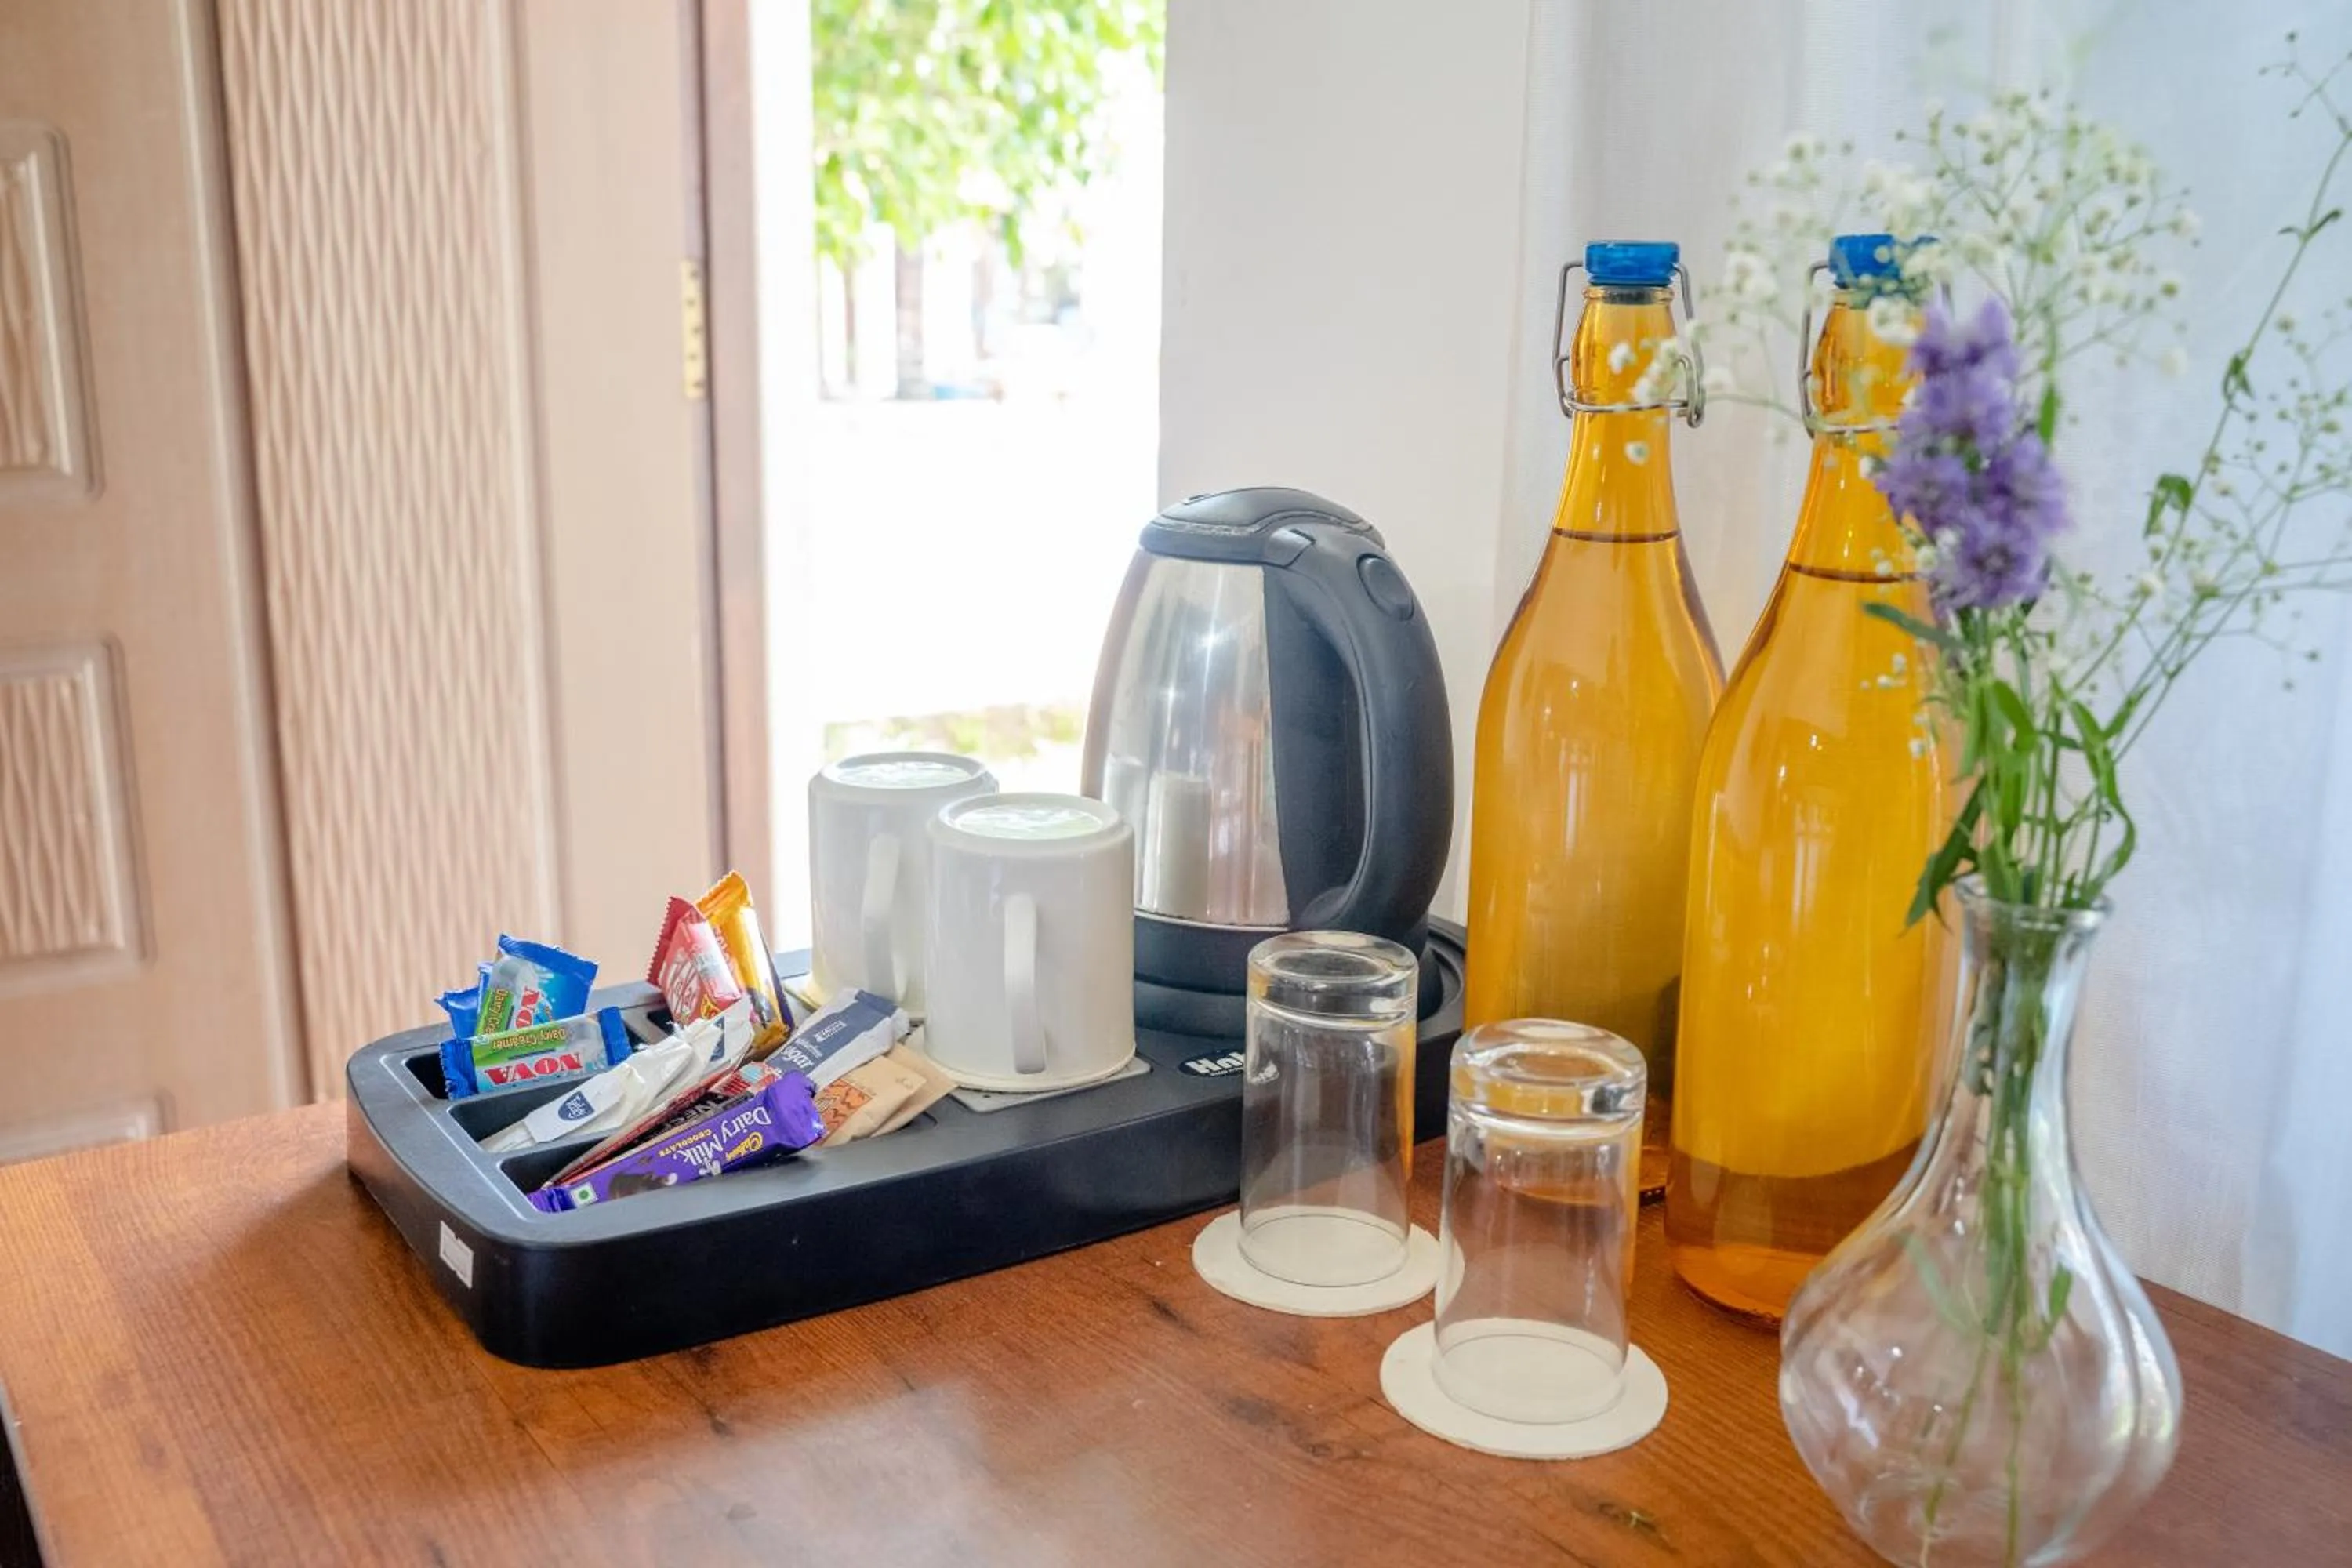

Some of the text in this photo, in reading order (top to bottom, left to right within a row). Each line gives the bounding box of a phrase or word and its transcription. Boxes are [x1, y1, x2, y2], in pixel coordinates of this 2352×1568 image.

[485, 1052, 583, 1085] NOVA
[658, 1128, 712, 1157] CHOCOLATE
[677, 1105, 771, 1166] Dairy Milk
